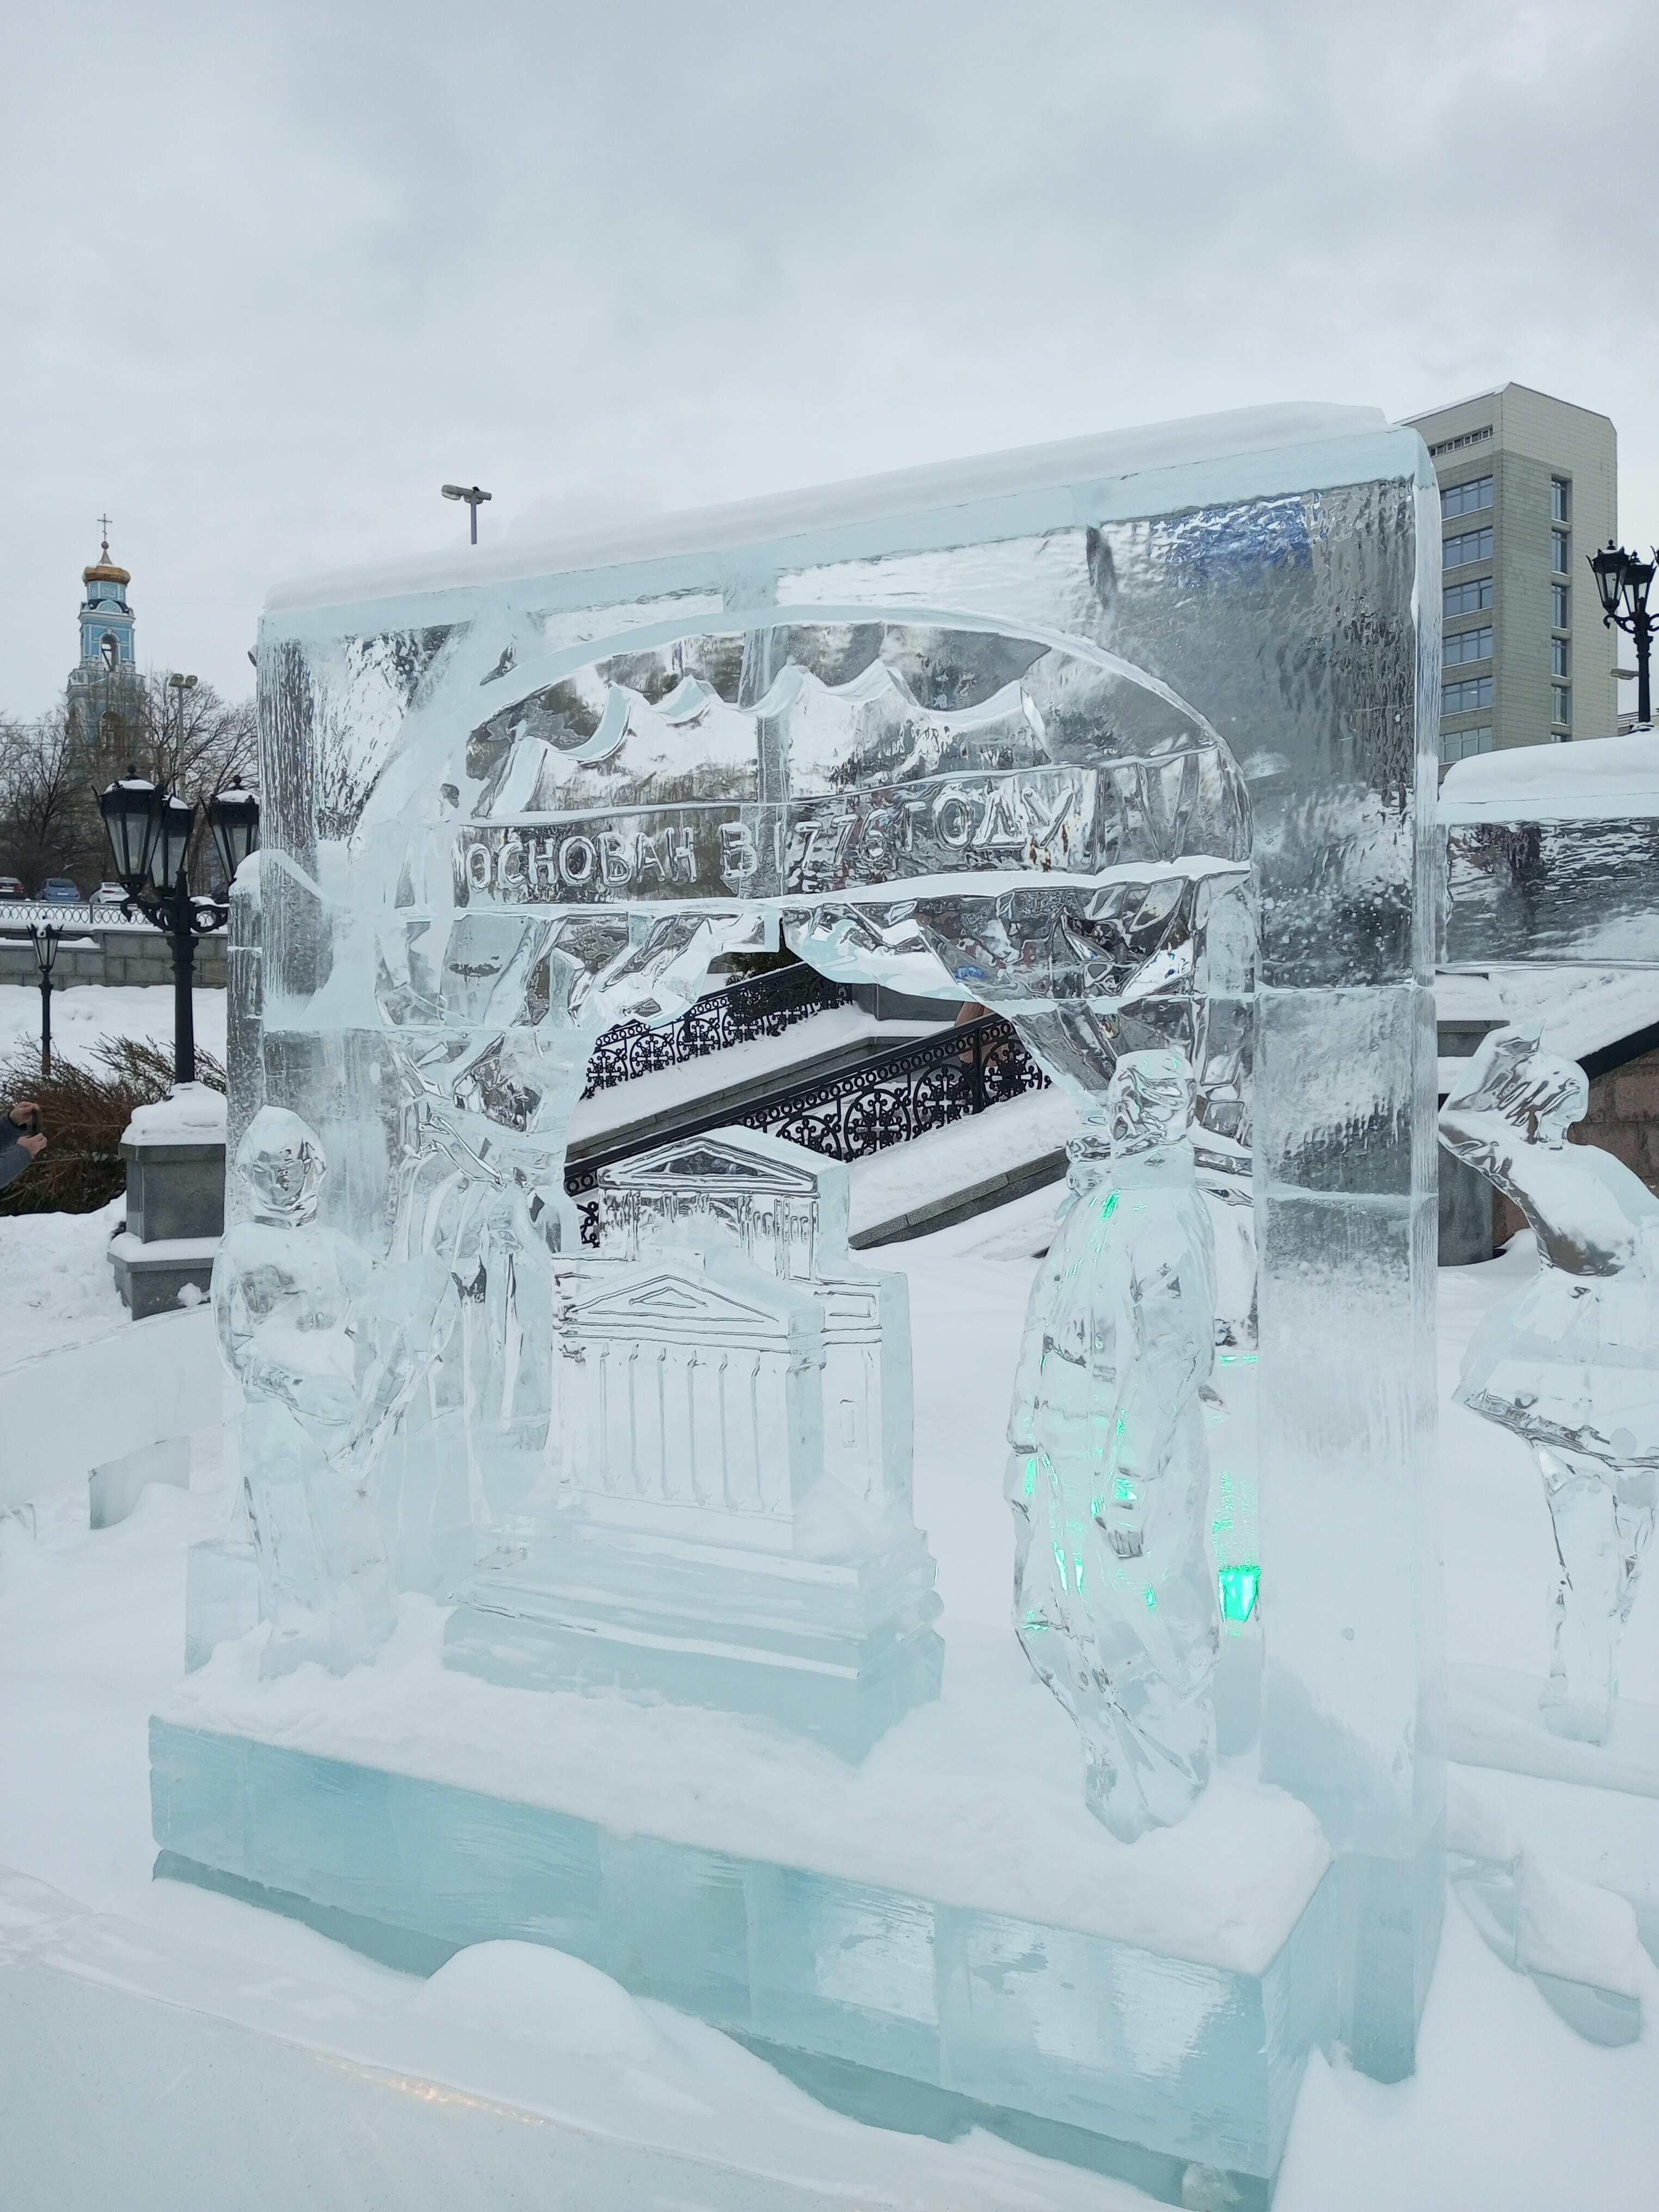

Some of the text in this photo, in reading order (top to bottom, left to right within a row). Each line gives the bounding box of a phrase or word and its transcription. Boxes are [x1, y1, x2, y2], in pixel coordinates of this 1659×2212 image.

[465, 827, 696, 894] ОСНОВАН
[718, 821, 759, 879] В
[900, 787, 1076, 852] ГОДУ
